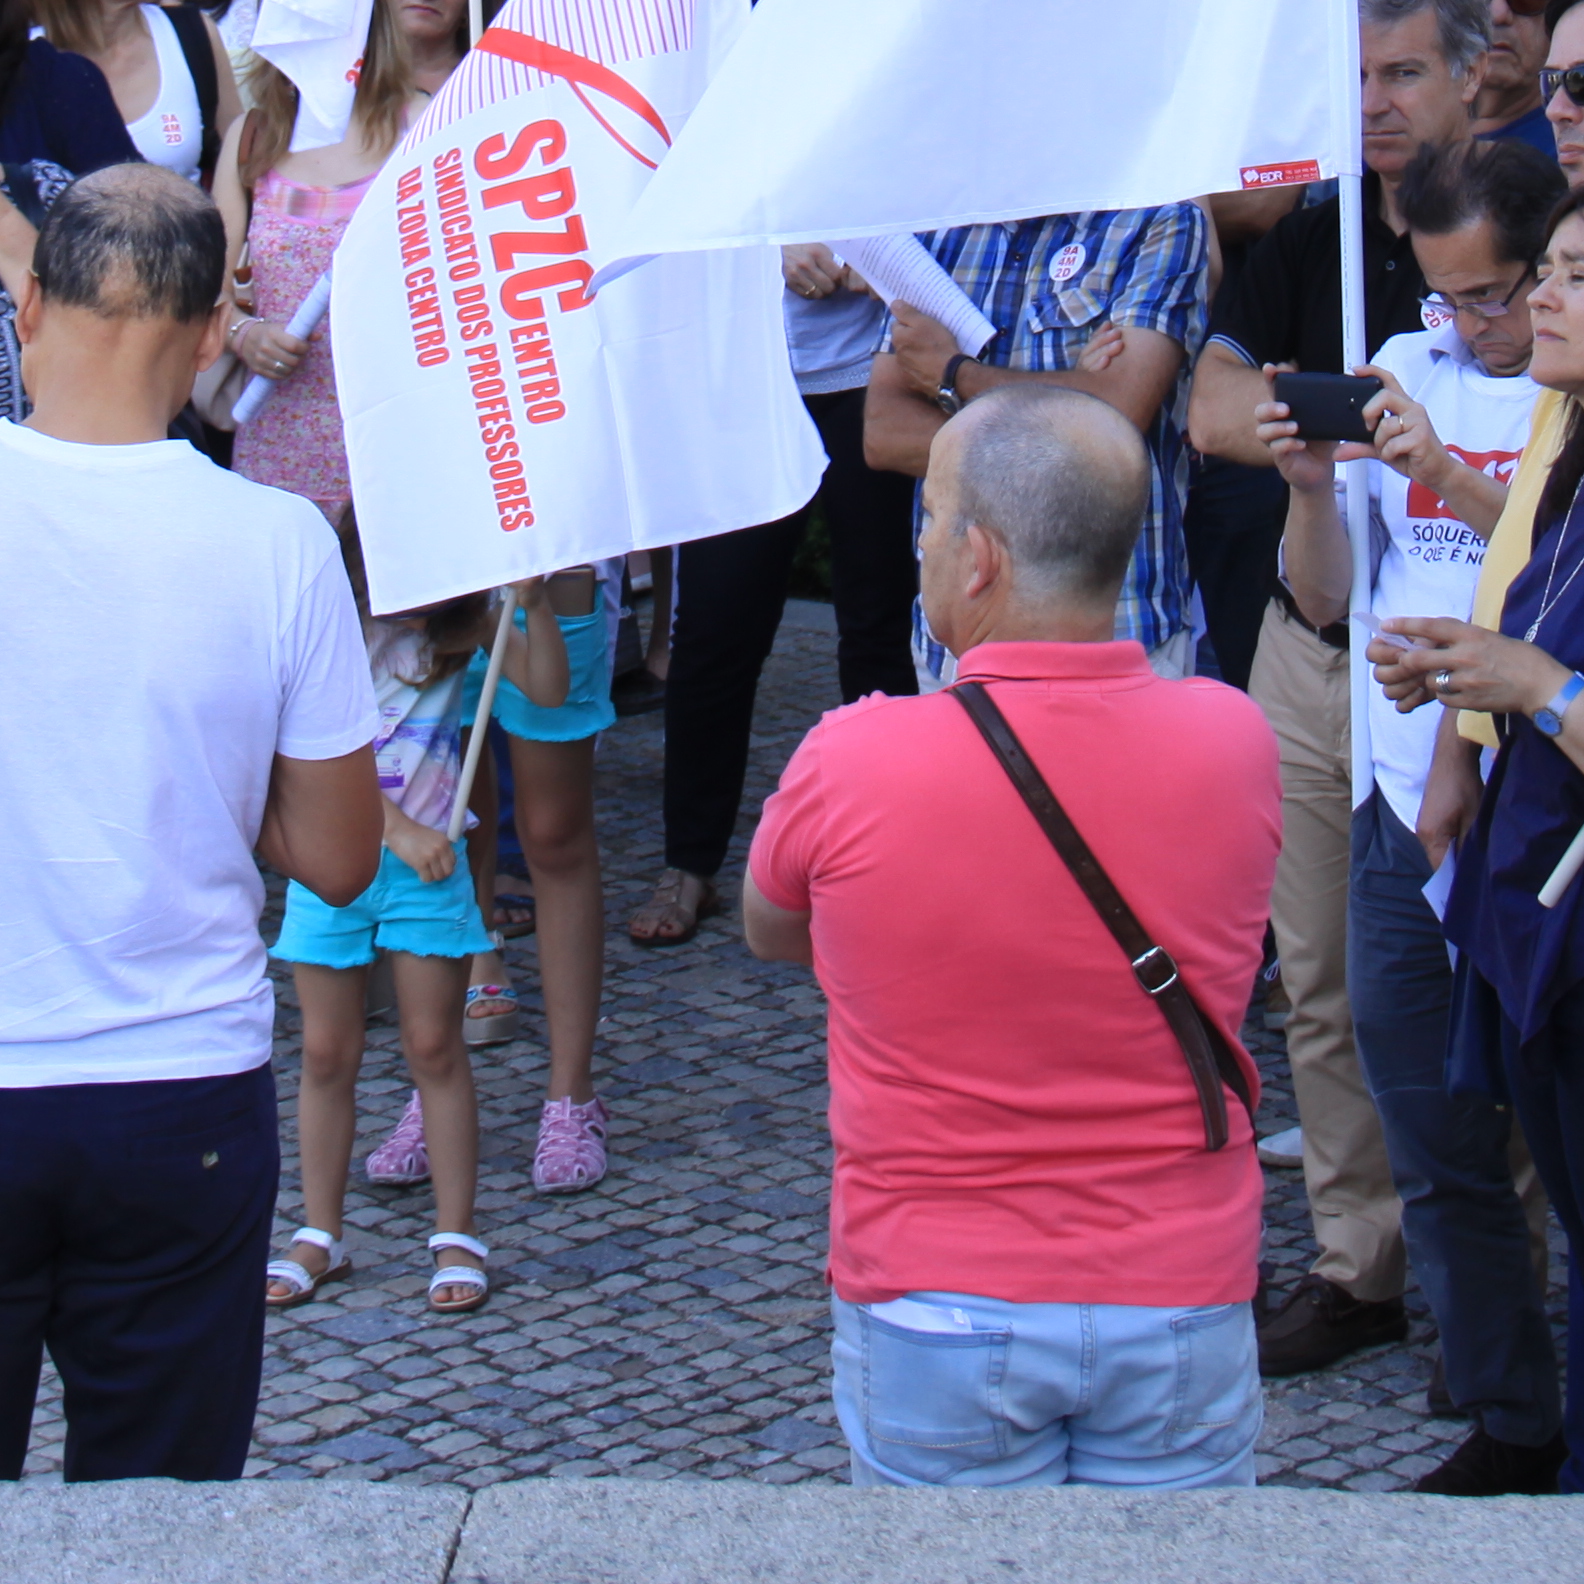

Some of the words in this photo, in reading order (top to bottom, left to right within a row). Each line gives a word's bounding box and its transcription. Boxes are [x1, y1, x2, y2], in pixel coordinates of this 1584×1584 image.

[396, 165, 422, 204] DA
[1260, 170, 1283, 183] BDR
[433, 146, 482, 282] SINDICATO
[397, 199, 429, 269] ZONA
[1058, 256, 1077, 266] 4M
[1063, 246, 1079, 256] 9A
[1055, 267, 1072, 278] 2D
[403, 268, 451, 369] CENTRO
[452, 282, 494, 341] DOS
[1423, 308, 1441, 328] 2D
[464, 342, 536, 534] PROFESSORES
[1450, 546, 1461, 562] É
